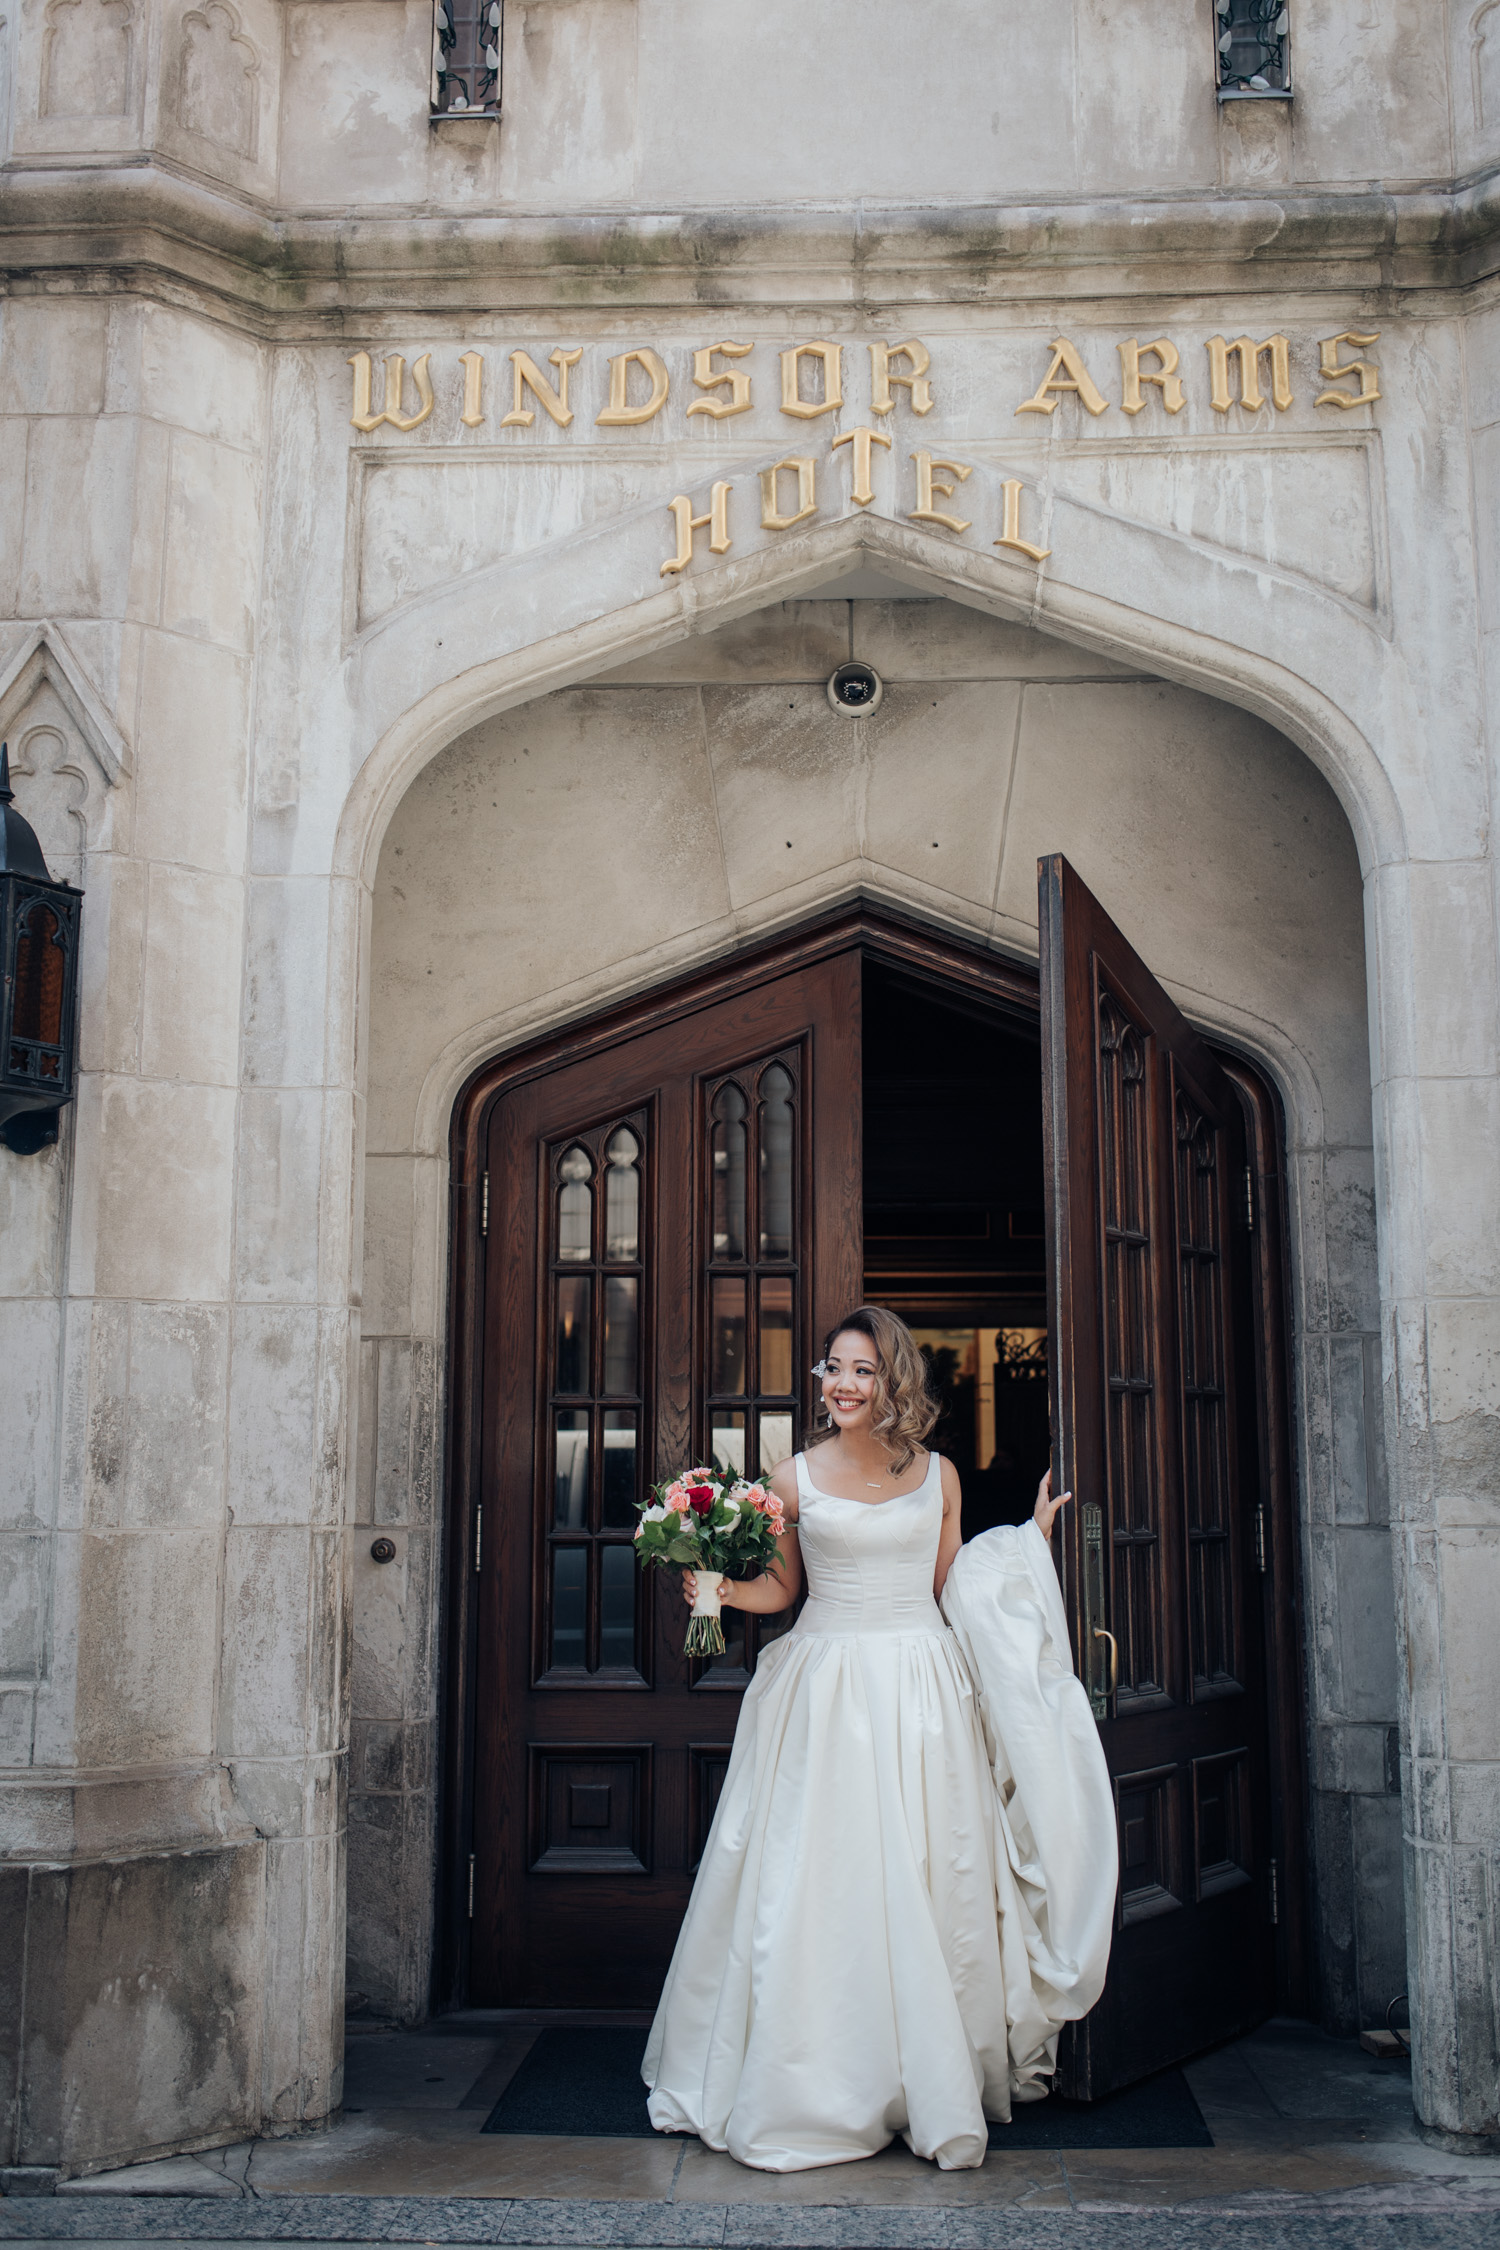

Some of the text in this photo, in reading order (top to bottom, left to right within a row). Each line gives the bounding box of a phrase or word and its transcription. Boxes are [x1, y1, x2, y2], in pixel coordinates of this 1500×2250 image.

[347, 329, 1382, 432] WINDSOR ARMS
[660, 426, 1052, 577] HOTEL
